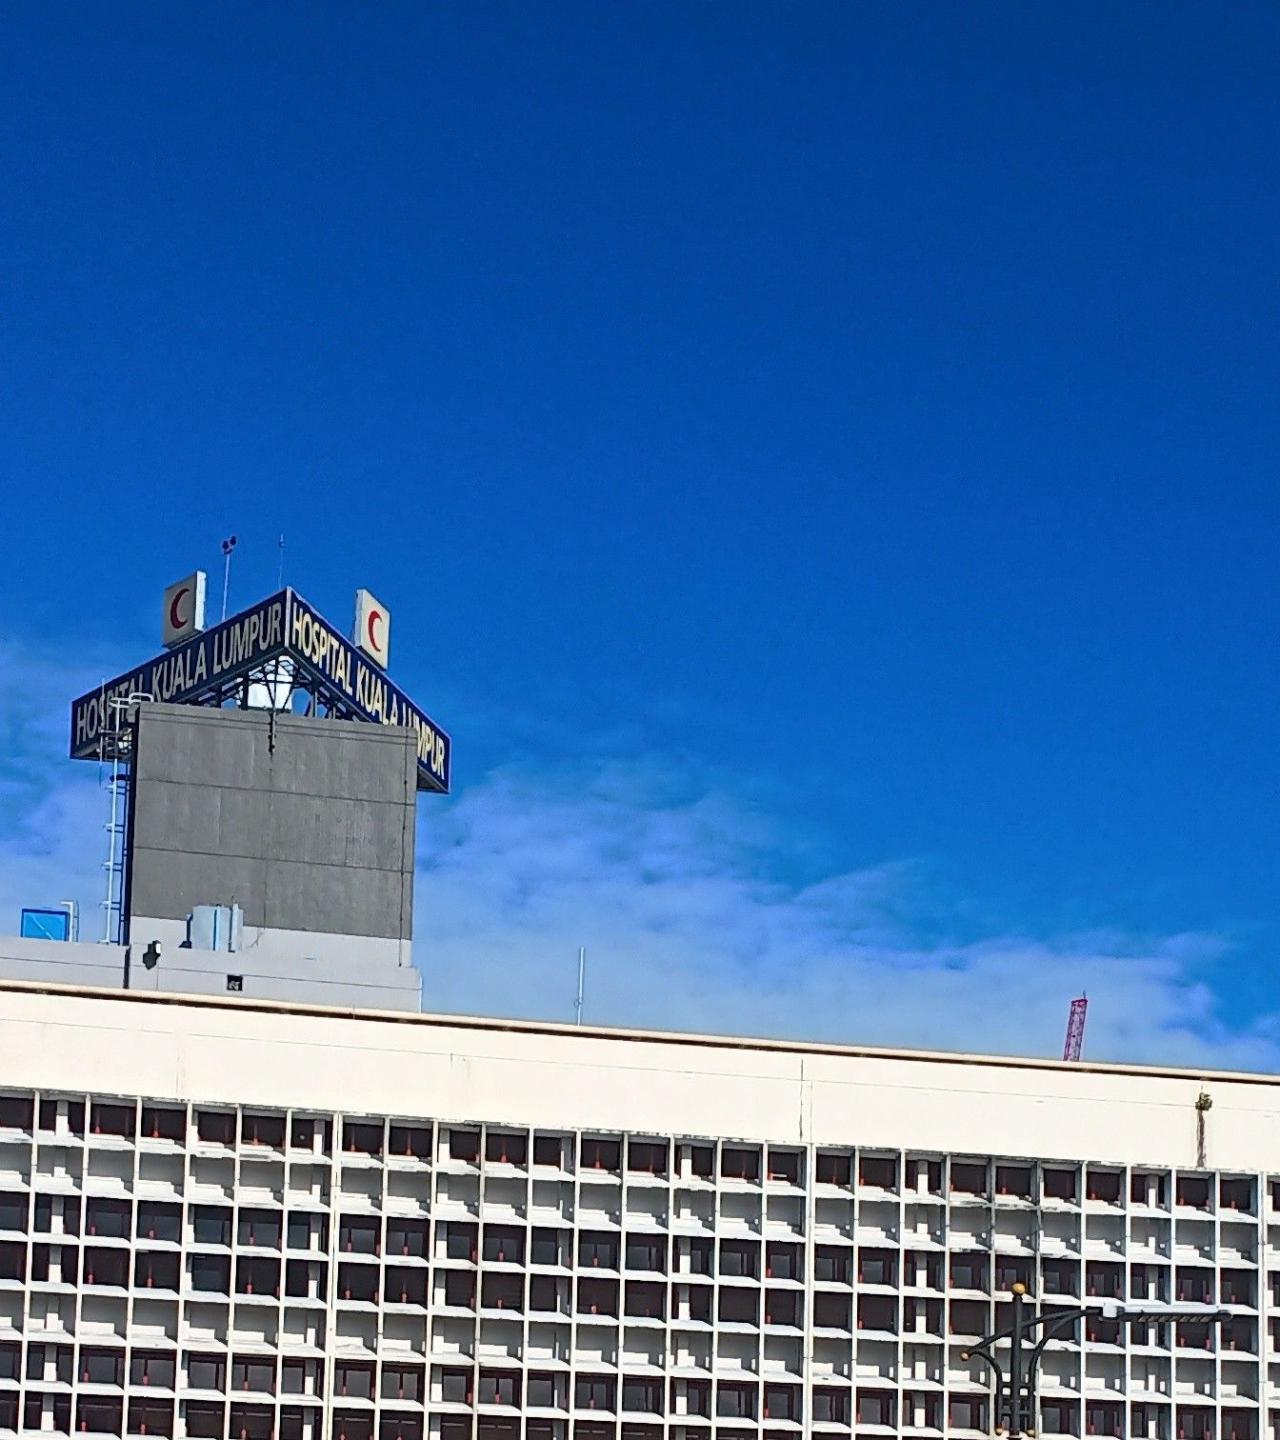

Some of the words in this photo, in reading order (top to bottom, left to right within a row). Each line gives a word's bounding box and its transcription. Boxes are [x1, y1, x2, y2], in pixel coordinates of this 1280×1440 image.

[151, 642, 207, 703] KUALA
[213, 602, 282, 674] LUMPUR
[292, 602, 353, 695] HOSPITAL
[356, 660, 398, 725] KUALA
